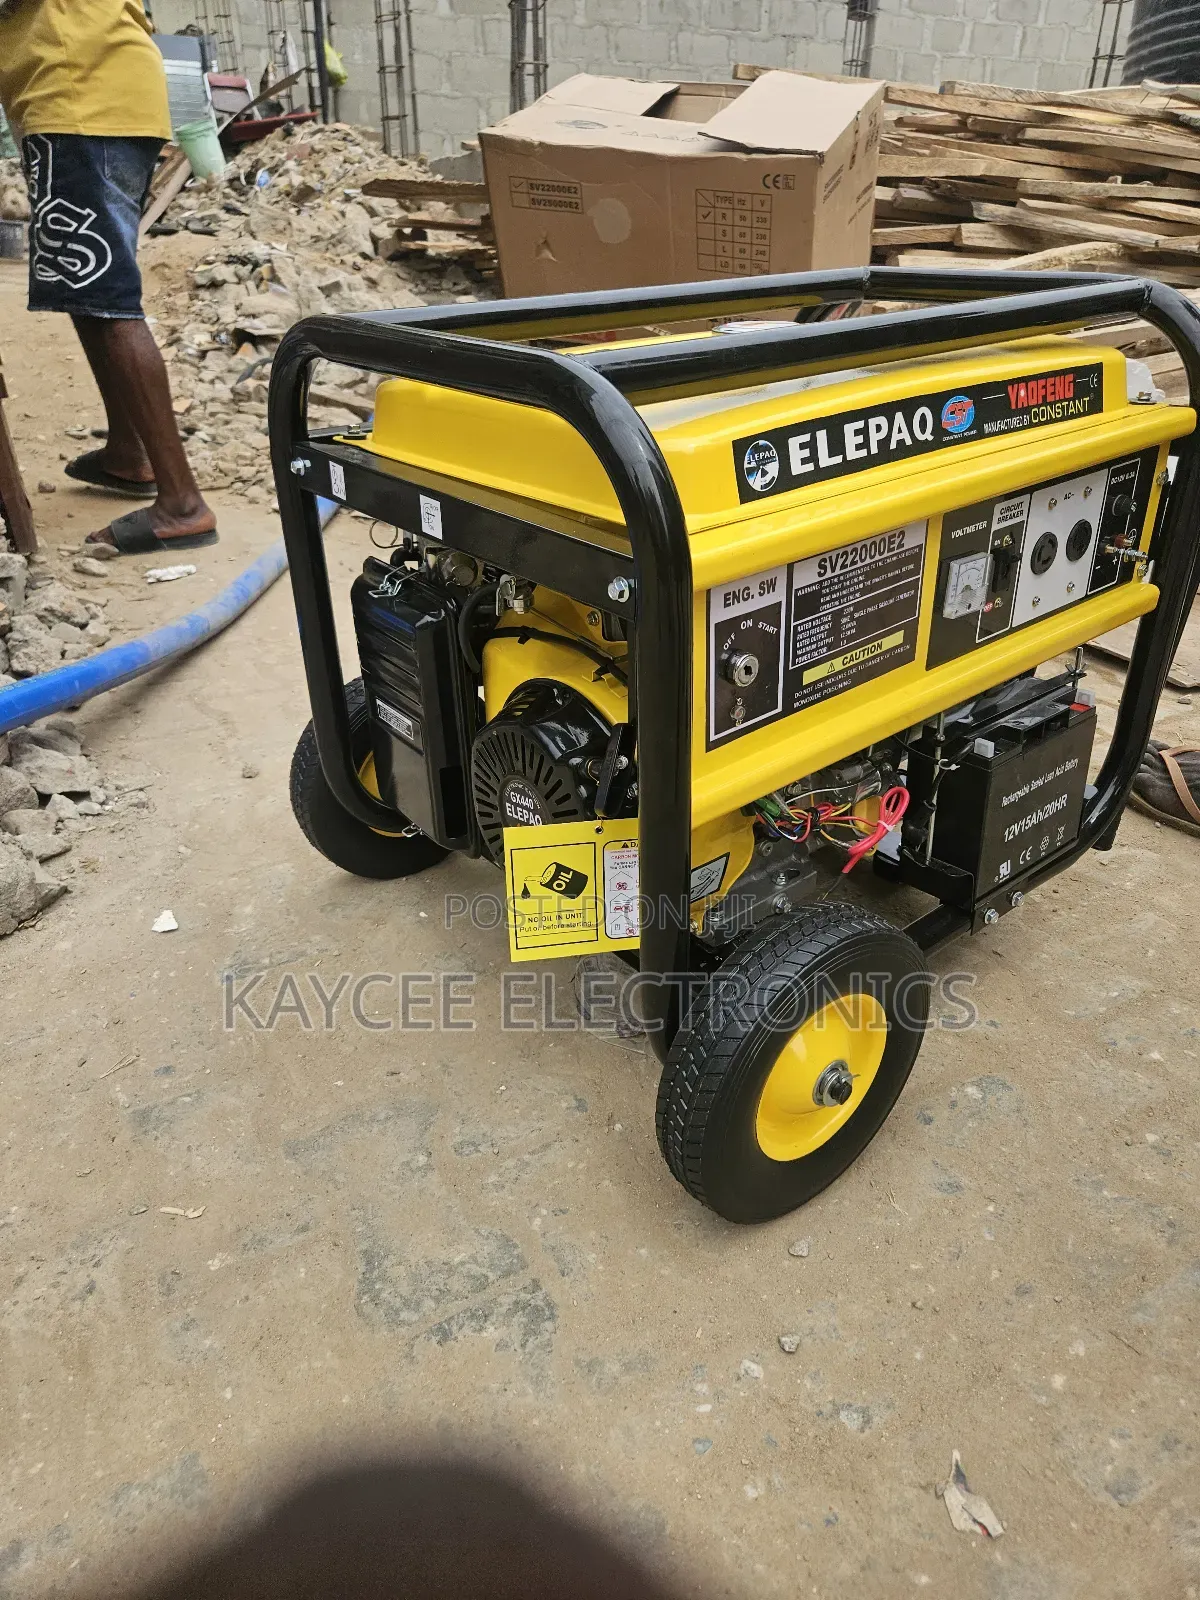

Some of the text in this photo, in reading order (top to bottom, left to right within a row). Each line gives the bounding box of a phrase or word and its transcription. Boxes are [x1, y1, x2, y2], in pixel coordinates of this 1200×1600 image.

[529, 183, 578, 194] SV22000E2
[531, 198, 580, 210] SV25000E2
[716, 195, 733, 205] TYPE
[1008, 373, 1074, 409] YAOFENG
[984, 397, 1090, 434] MANUFACTURED BY CONSTANT
[788, 406, 934, 476] ELEPAQ
[1000, 501, 1024, 515] CIRCUIT
[997, 510, 1024, 525] BREAKER
[951, 520, 987, 539] VOLTMETER
[817, 530, 906, 578] SV22000E2
[723, 576, 777, 609] ENG. SW
[740, 618, 753, 630] ON
[757, 621, 778, 635] START
[798, 621, 812, 632] RATED
[812, 614, 832, 628] VOLTAGE
[810, 622, 833, 636] FREQUENCY
[723, 632, 736, 651] OFF
[797, 638, 810, 648] RATED
[810, 631, 828, 643] OUTPUT
[817, 636, 835, 648] OUTPUT
[795, 653, 811, 665] POWER
[811, 647, 828, 658] FACTOR
[841, 641, 883, 666] CAUTION
[794, 691, 803, 699] DO
[803, 687, 814, 695] NOT
[814, 682, 825, 690] USE
[847, 667, 857, 676] DUE
[858, 663, 865, 671] TO
[793, 691, 822, 709] MONOXIDE
[1064, 758, 1079, 772] Battery
[510, 791, 534, 810] GX440
[1004, 793, 1068, 843] 12V15Ah/20HR
[1019, 846, 1033, 865] CE
[552, 870, 573, 891] OIL
[543, 923, 565, 931] before
